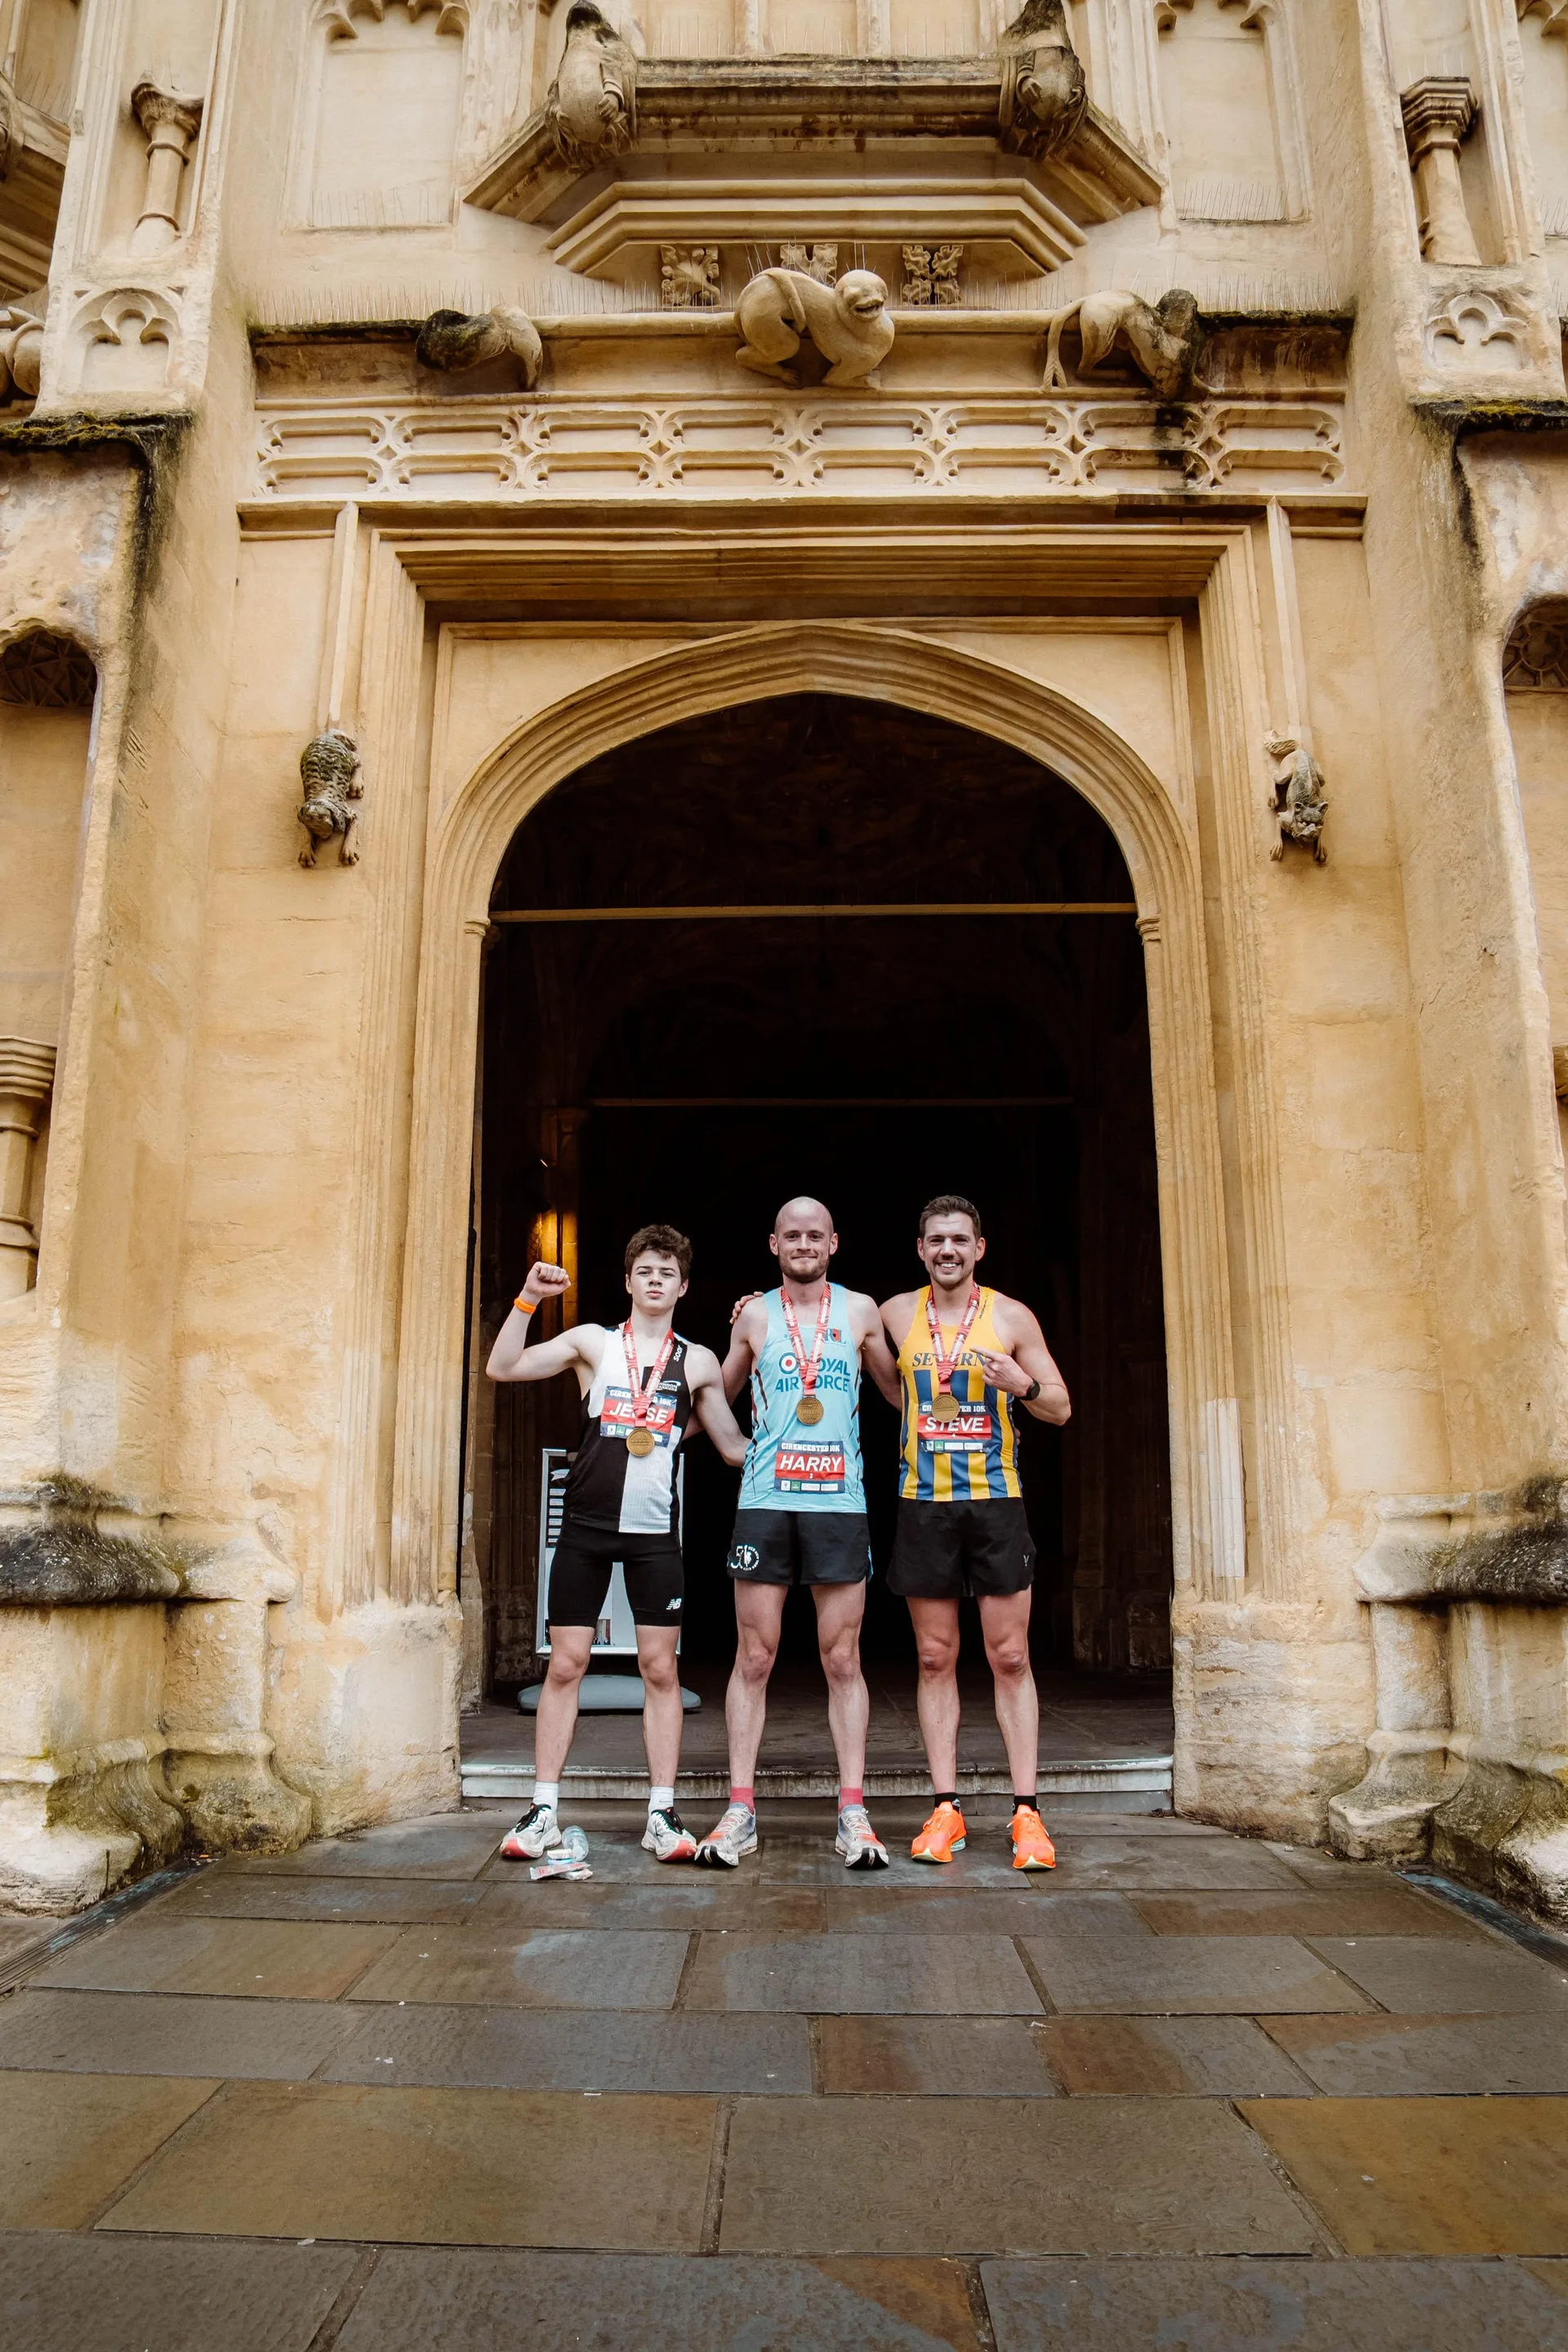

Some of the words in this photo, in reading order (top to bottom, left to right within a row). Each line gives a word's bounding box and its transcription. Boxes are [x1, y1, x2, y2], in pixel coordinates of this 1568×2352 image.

[817, 1357, 851, 1376] OYAL
[912, 1352, 986, 1367] SERN
[775, 1376, 800, 1392] AIR
[814, 1374, 851, 1392] ORCE
[609, 1401, 669, 1424] JESE
[781, 1442, 829, 1452] CIRENCESTER
[780, 1454, 842, 1472] HARRY
